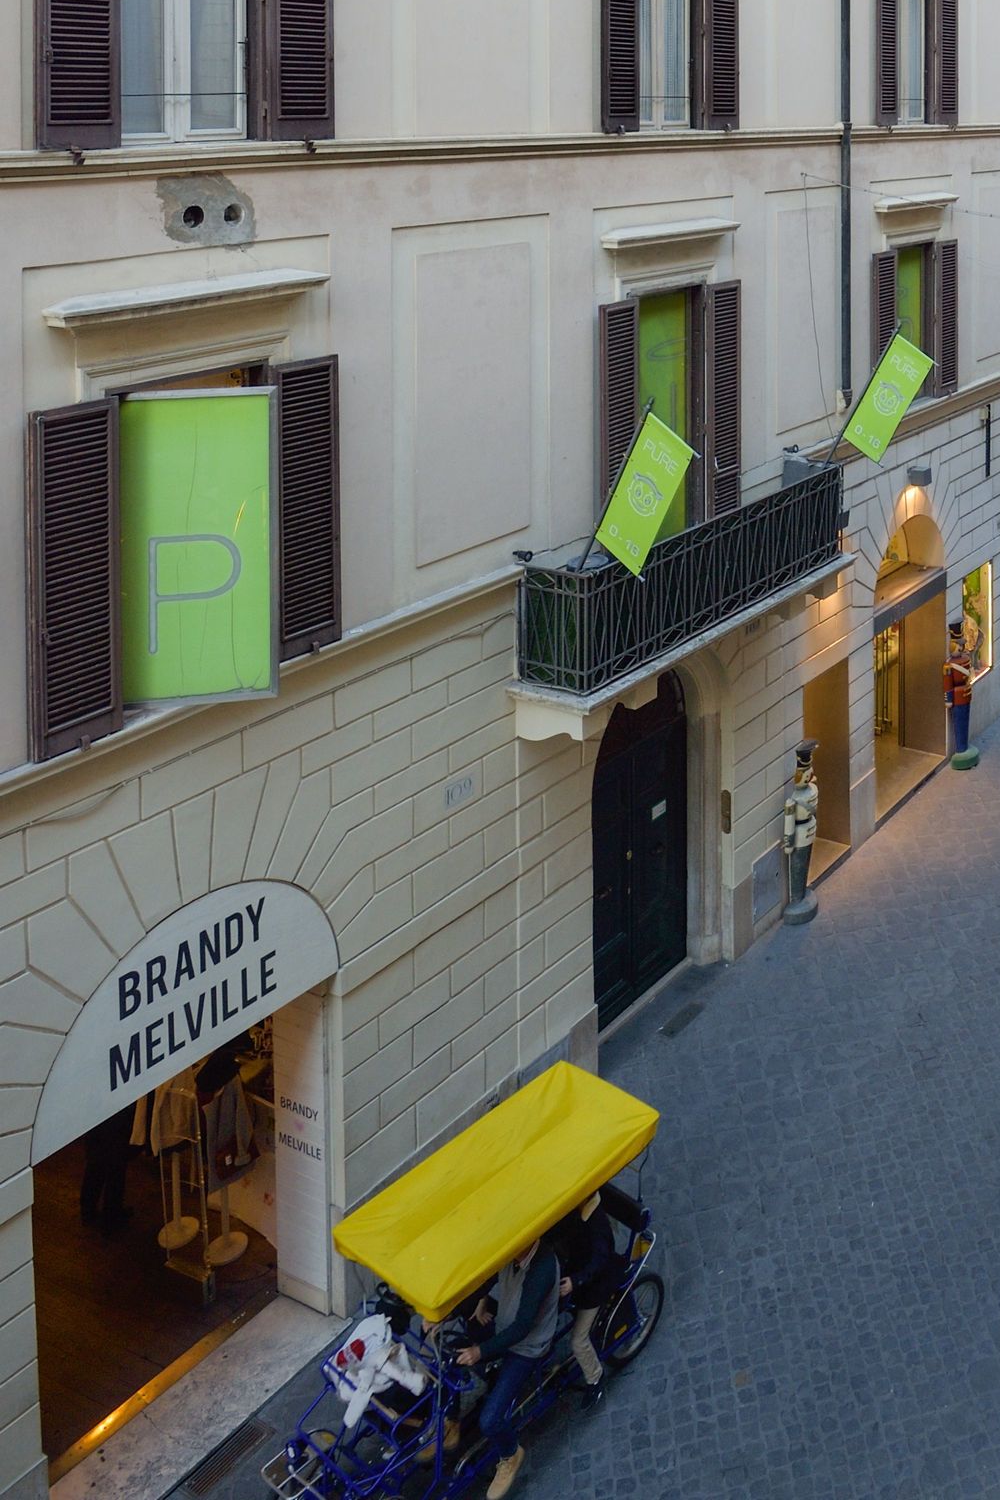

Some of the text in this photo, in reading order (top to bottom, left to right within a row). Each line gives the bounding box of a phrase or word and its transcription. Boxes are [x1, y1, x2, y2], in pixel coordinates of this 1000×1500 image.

[889, 354, 921, 382] PURE
[643, 438, 679, 477] PURE
[148, 534, 241, 654] P
[118, 896, 265, 1021] BRANDY
[109, 950, 278, 1092] MELVILLE
[280, 1096, 319, 1122] BRANDY
[278, 1131, 322, 1161] MELVILLE
